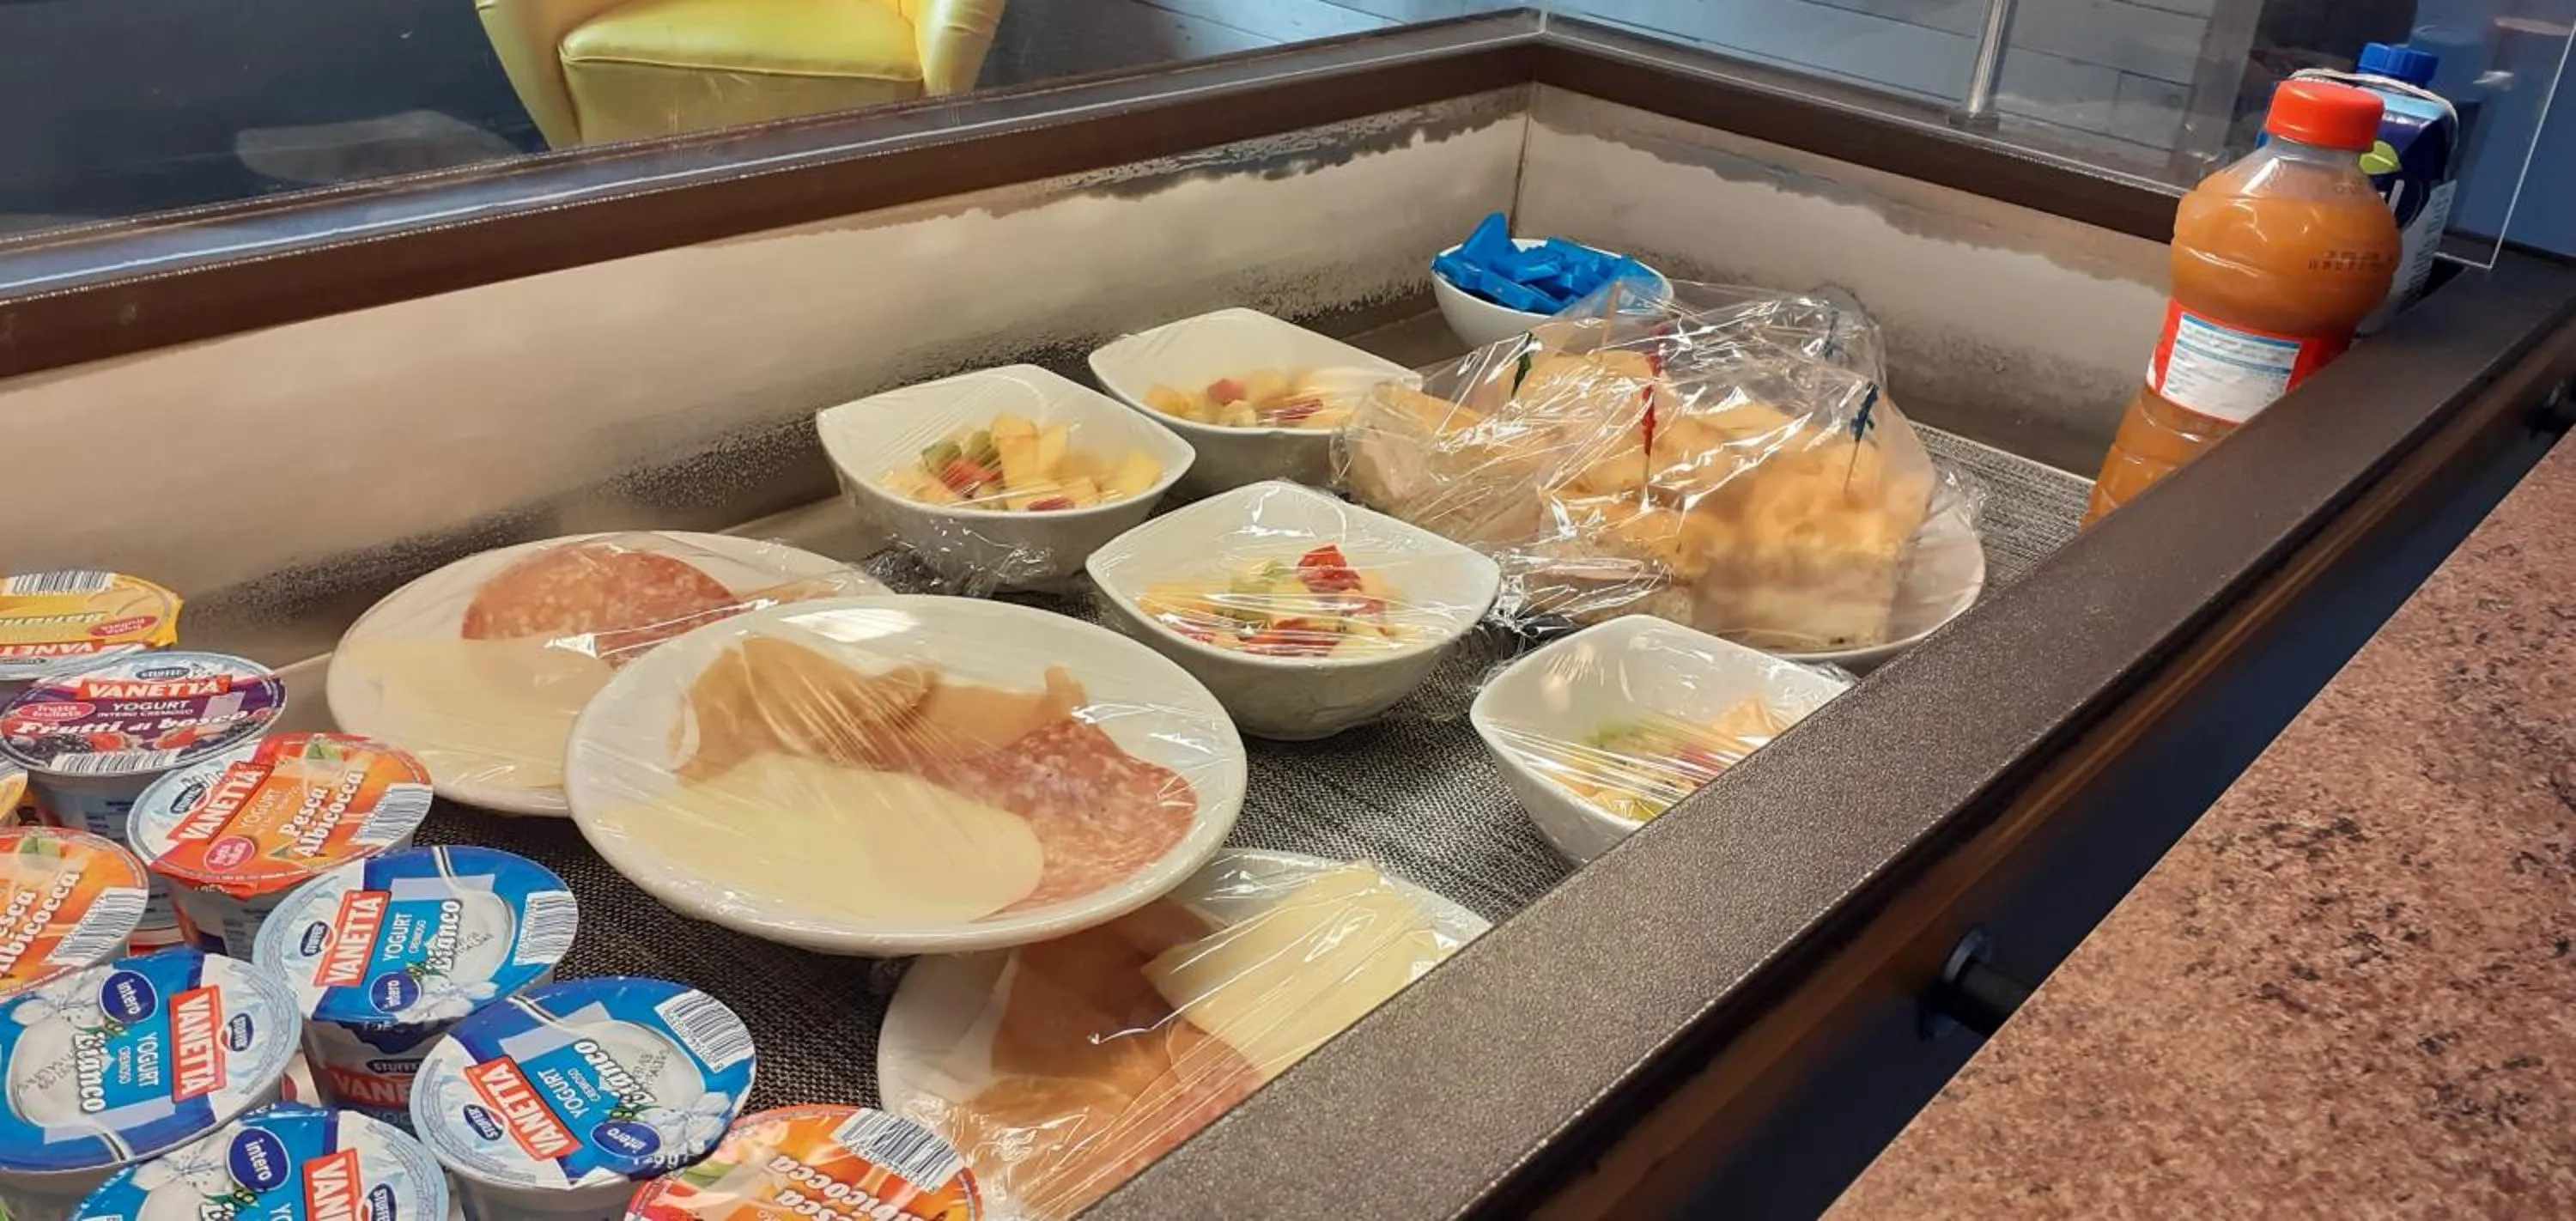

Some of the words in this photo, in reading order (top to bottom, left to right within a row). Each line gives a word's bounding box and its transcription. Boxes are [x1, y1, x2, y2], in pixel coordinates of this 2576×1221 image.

[89, 679, 221, 698] VANETTA
[113, 699, 190, 712] YOGURT
[14, 720, 124, 734] Frutti
[127, 722, 153, 732] di
[157, 710, 248, 729] bosco
[178, 769, 265, 839] VANETTA
[278, 787, 329, 838] Pesca
[293, 772, 364, 858] Albicocca
[323, 896, 384, 982] VANETTA
[382, 912, 413, 963] YOGURT
[116, 978, 143, 1016] intero
[385, 979, 402, 1009] intero
[137, 1031, 160, 1088] YOGURT
[177, 992, 216, 1096] VANETTA
[480, 1062, 571, 1156] VANETTA
[537, 1067, 591, 1120] YOGURT
[244, 1138, 273, 1182] intero
[606, 1127, 649, 1155] intero
